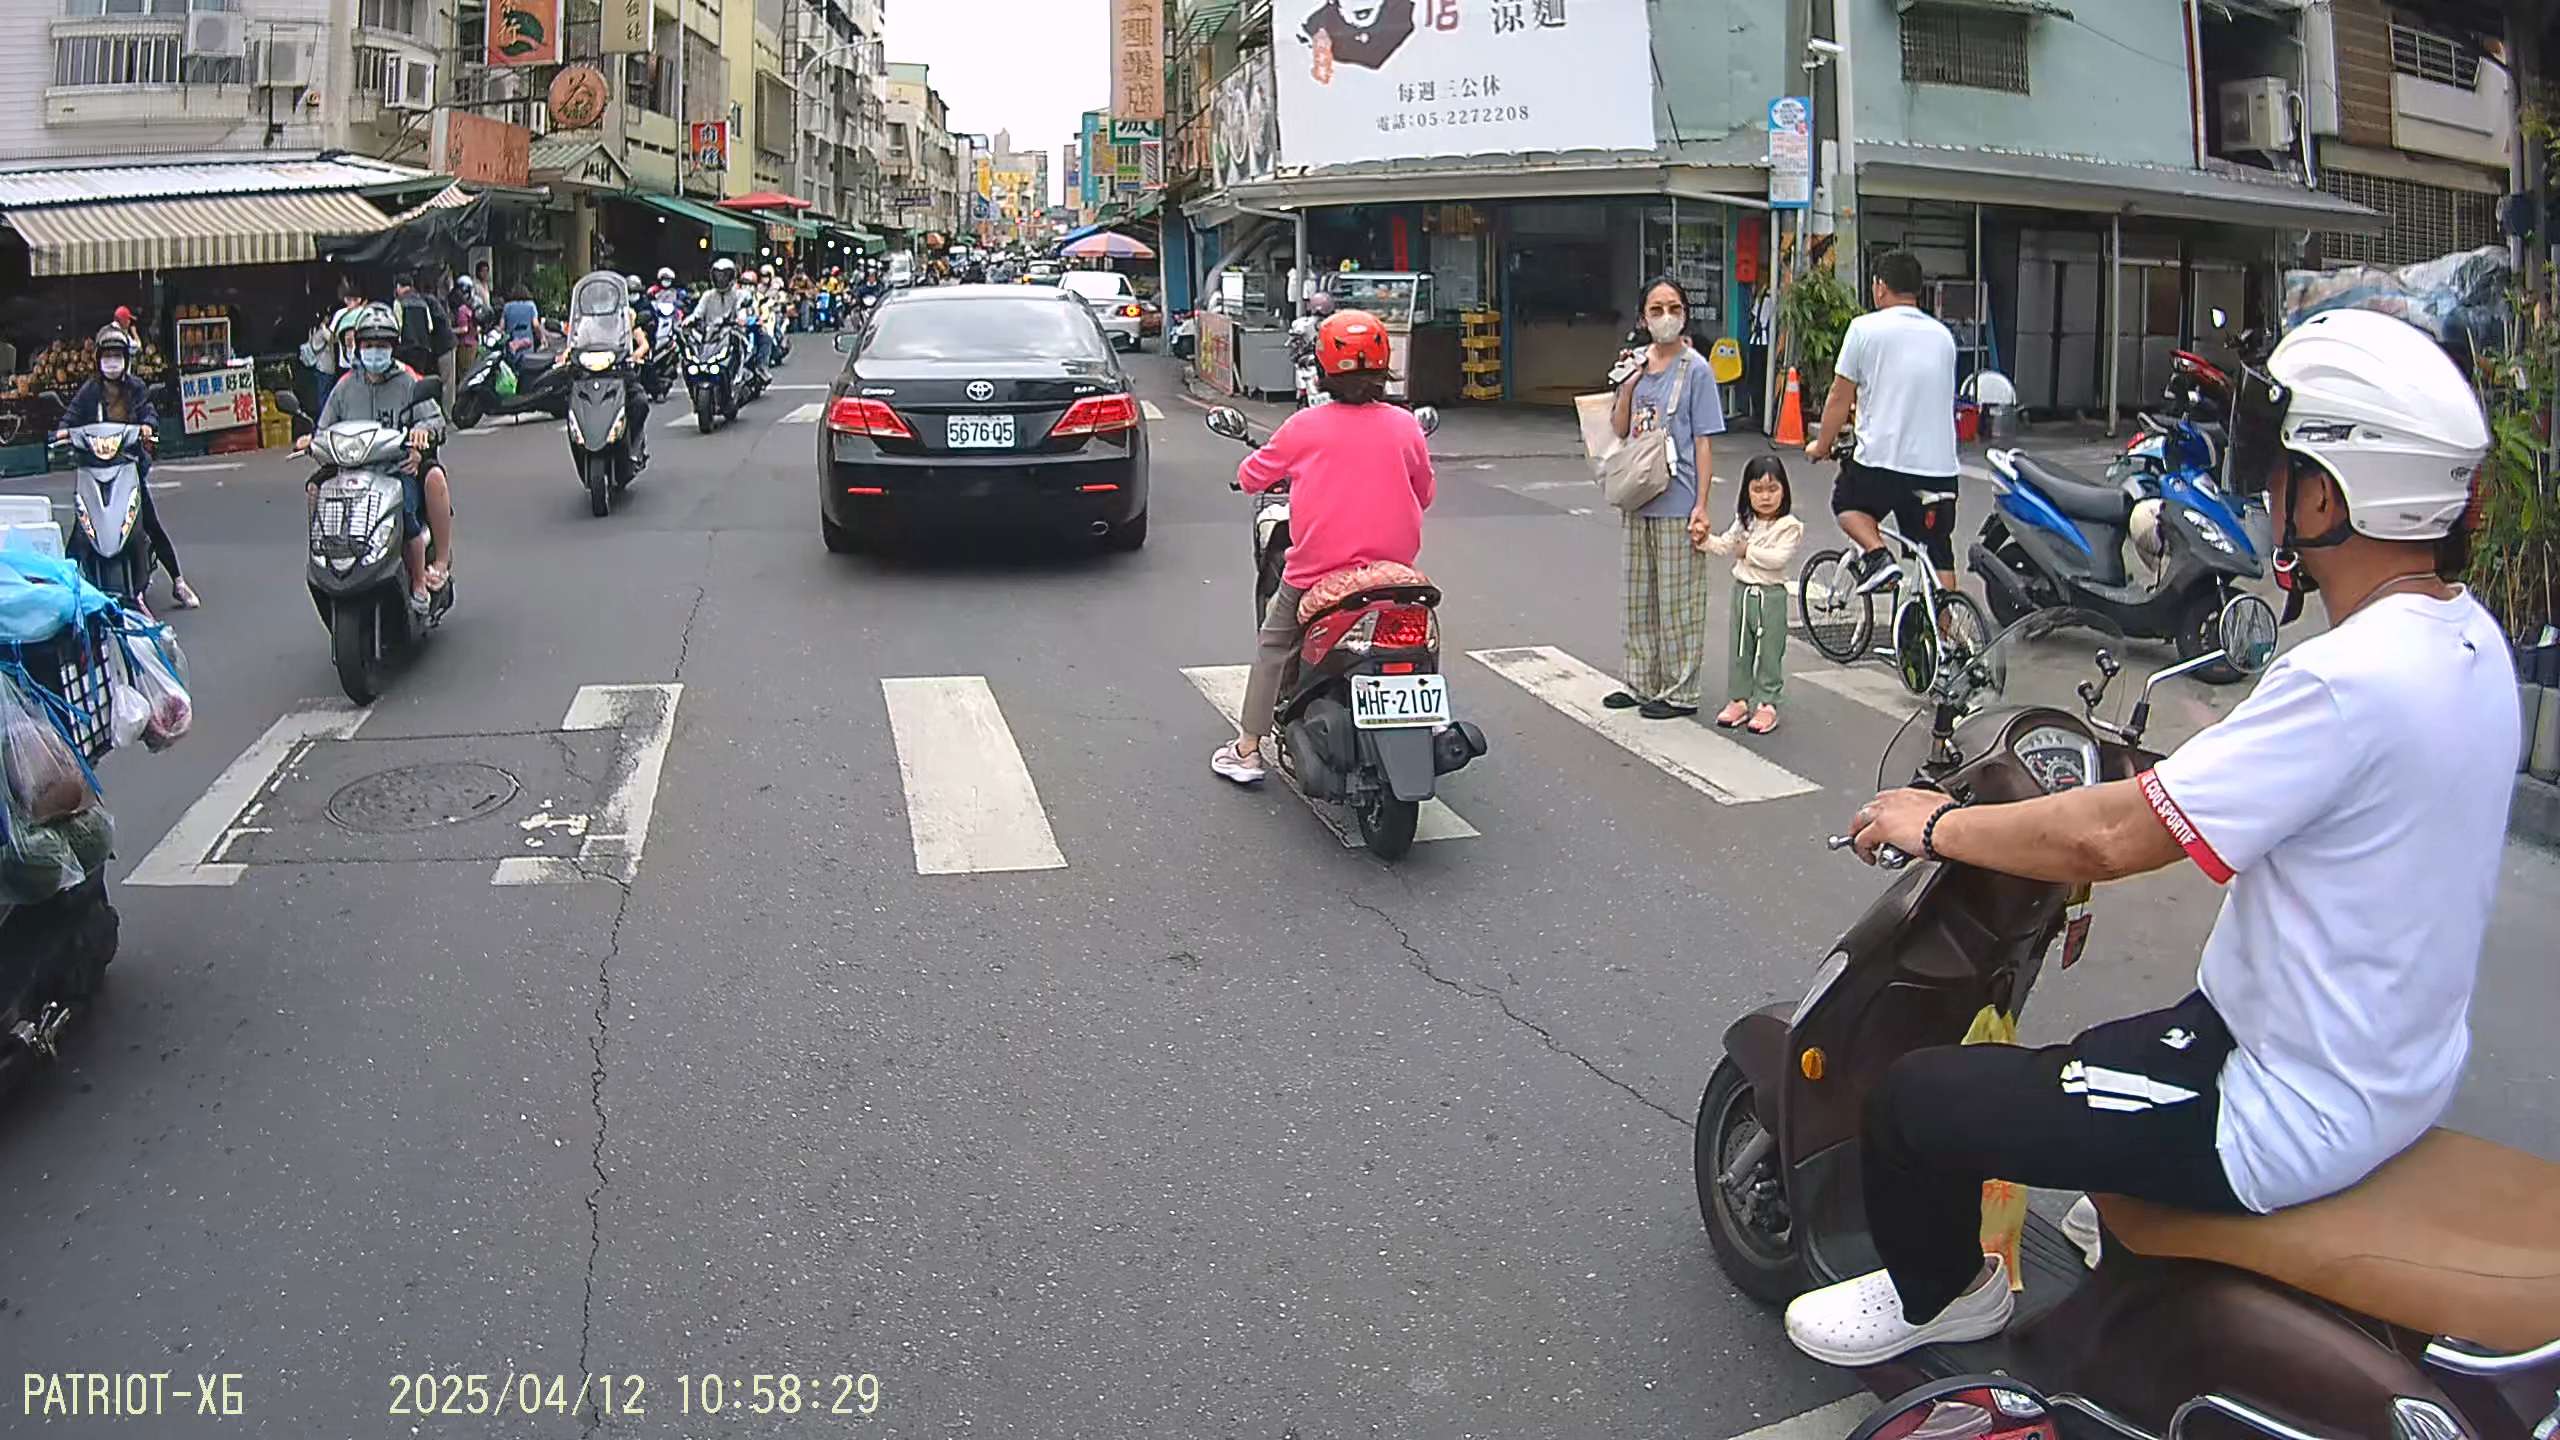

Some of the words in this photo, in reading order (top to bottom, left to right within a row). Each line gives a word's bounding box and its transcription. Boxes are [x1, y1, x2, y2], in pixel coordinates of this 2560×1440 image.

[1398, 74, 1501, 103] 每週三公休
[185, 392, 256, 430] 不一樣
[2157, 799, 2198, 845] SPORTIF
